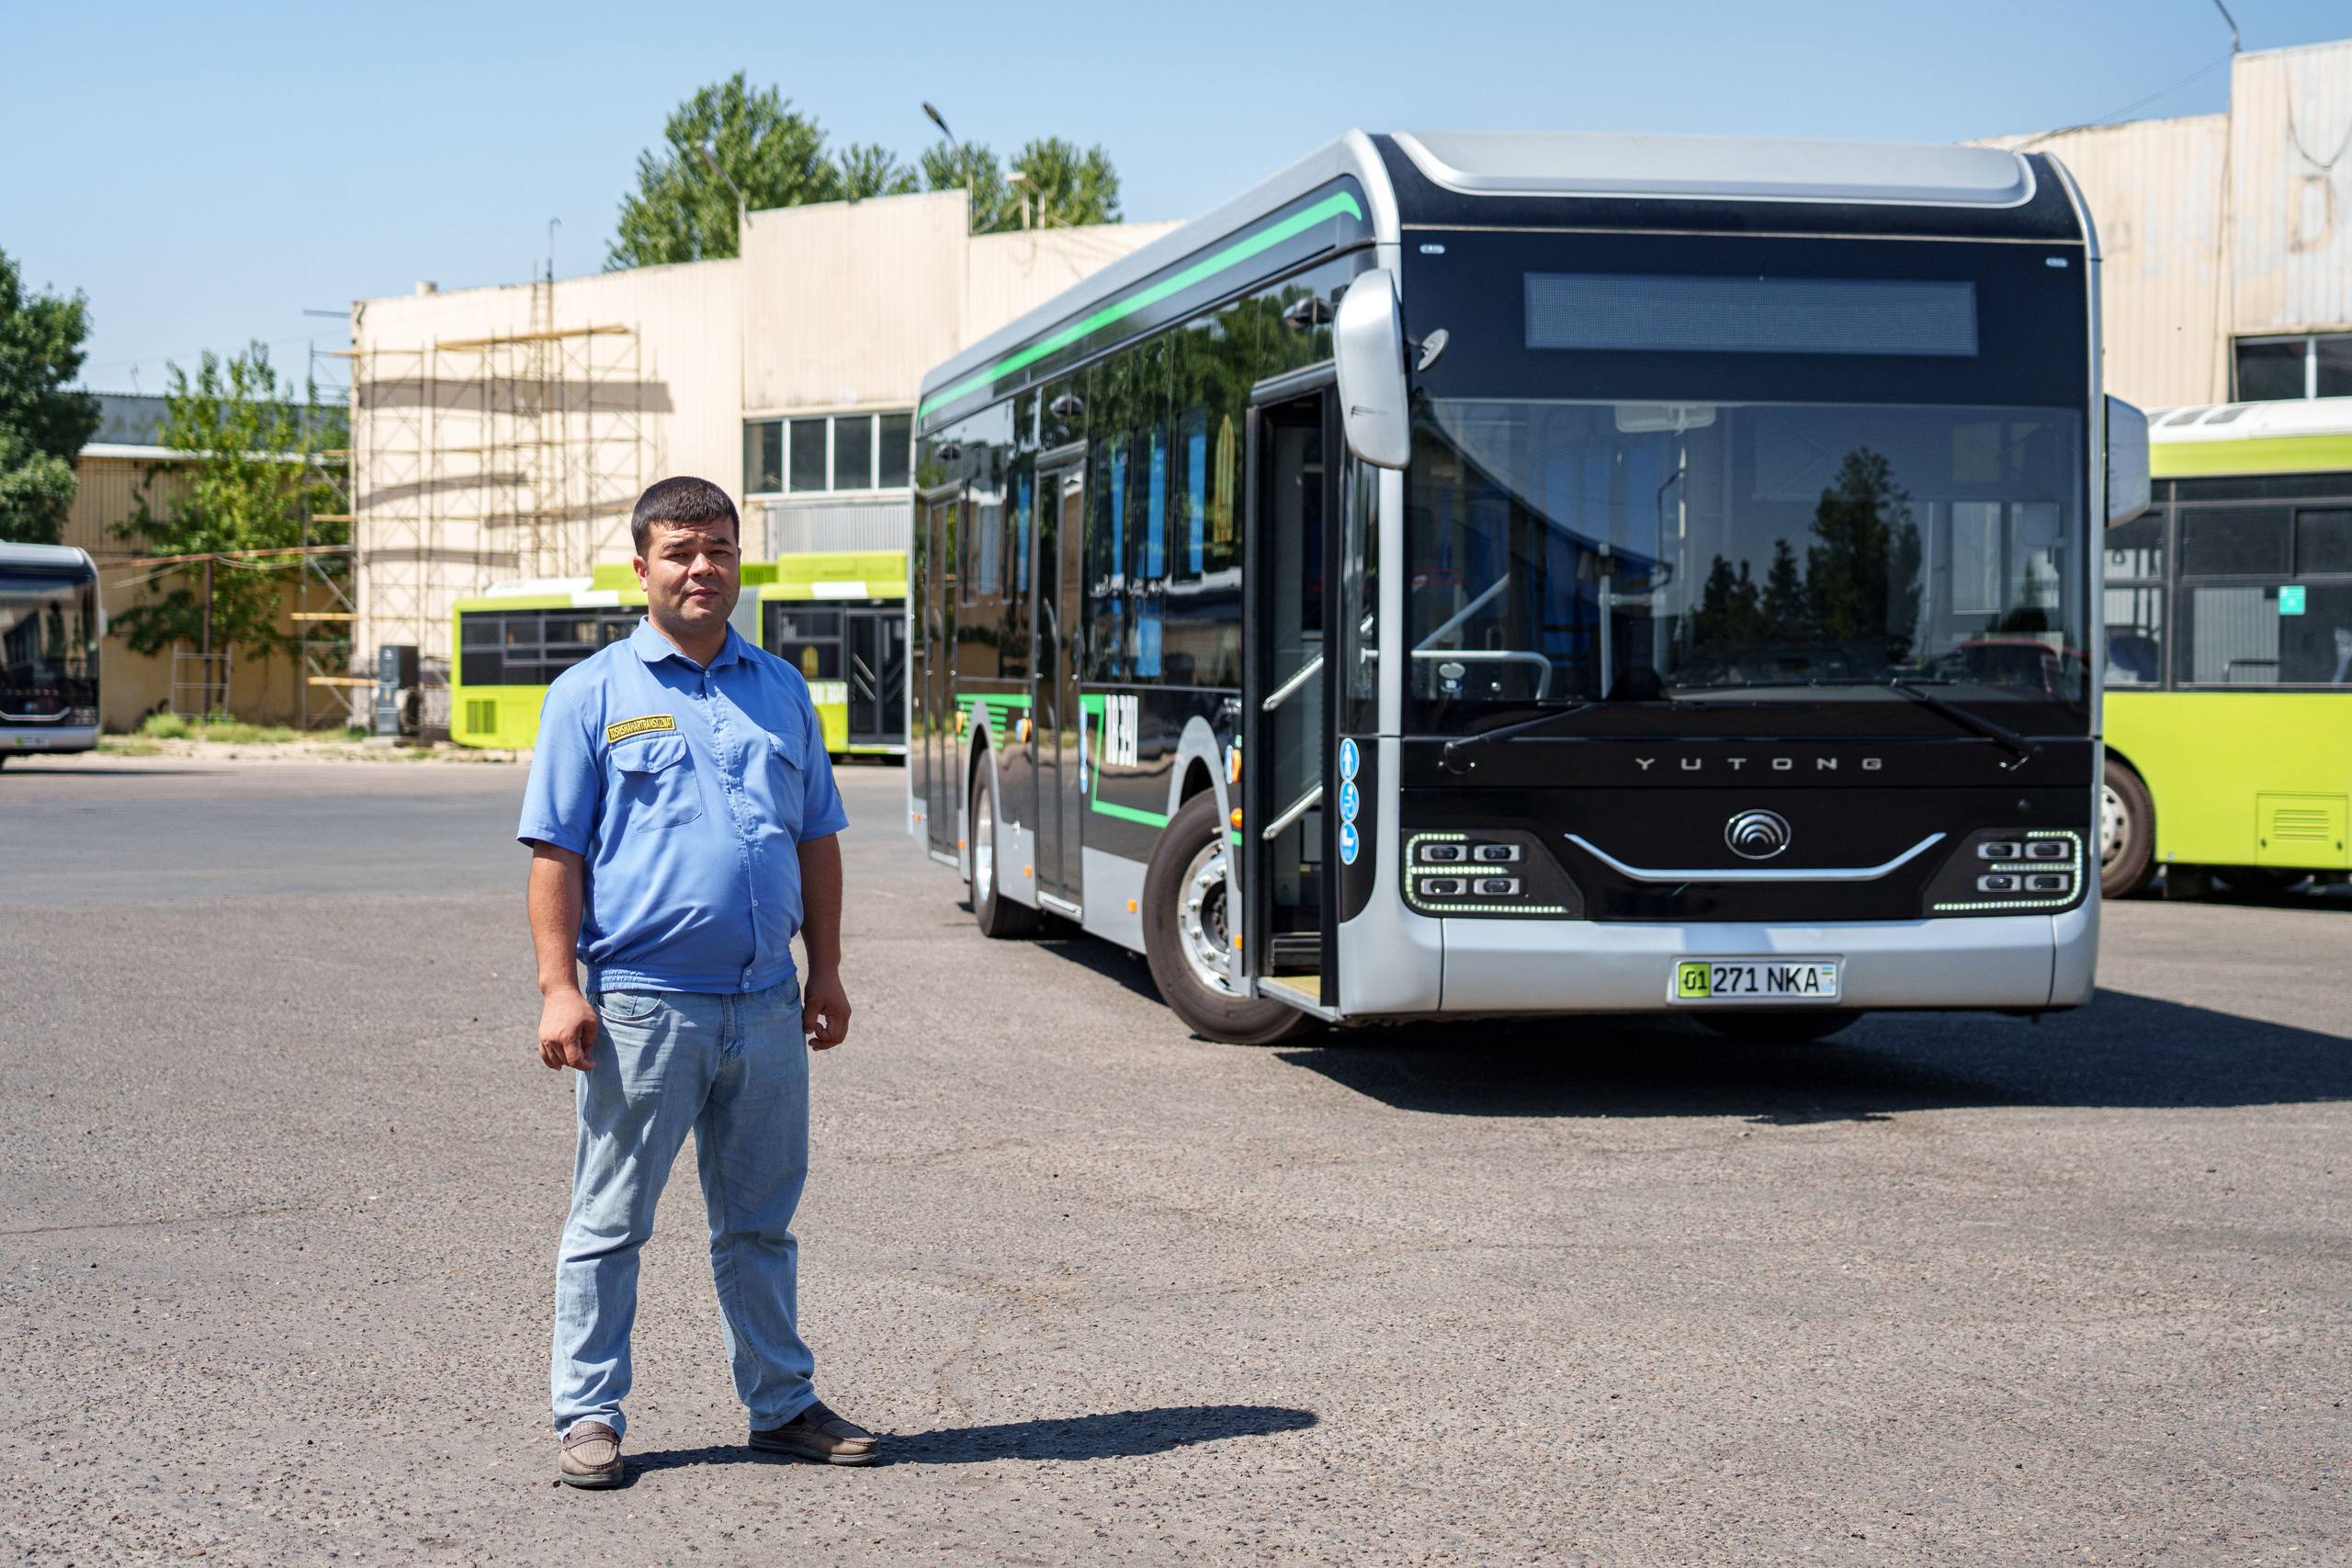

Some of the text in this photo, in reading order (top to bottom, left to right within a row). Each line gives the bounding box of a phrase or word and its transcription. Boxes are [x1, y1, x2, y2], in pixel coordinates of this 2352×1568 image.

[1635, 758, 1883, 771] YUTONG
[1685, 967, 1820, 992] 01 271 NKA
